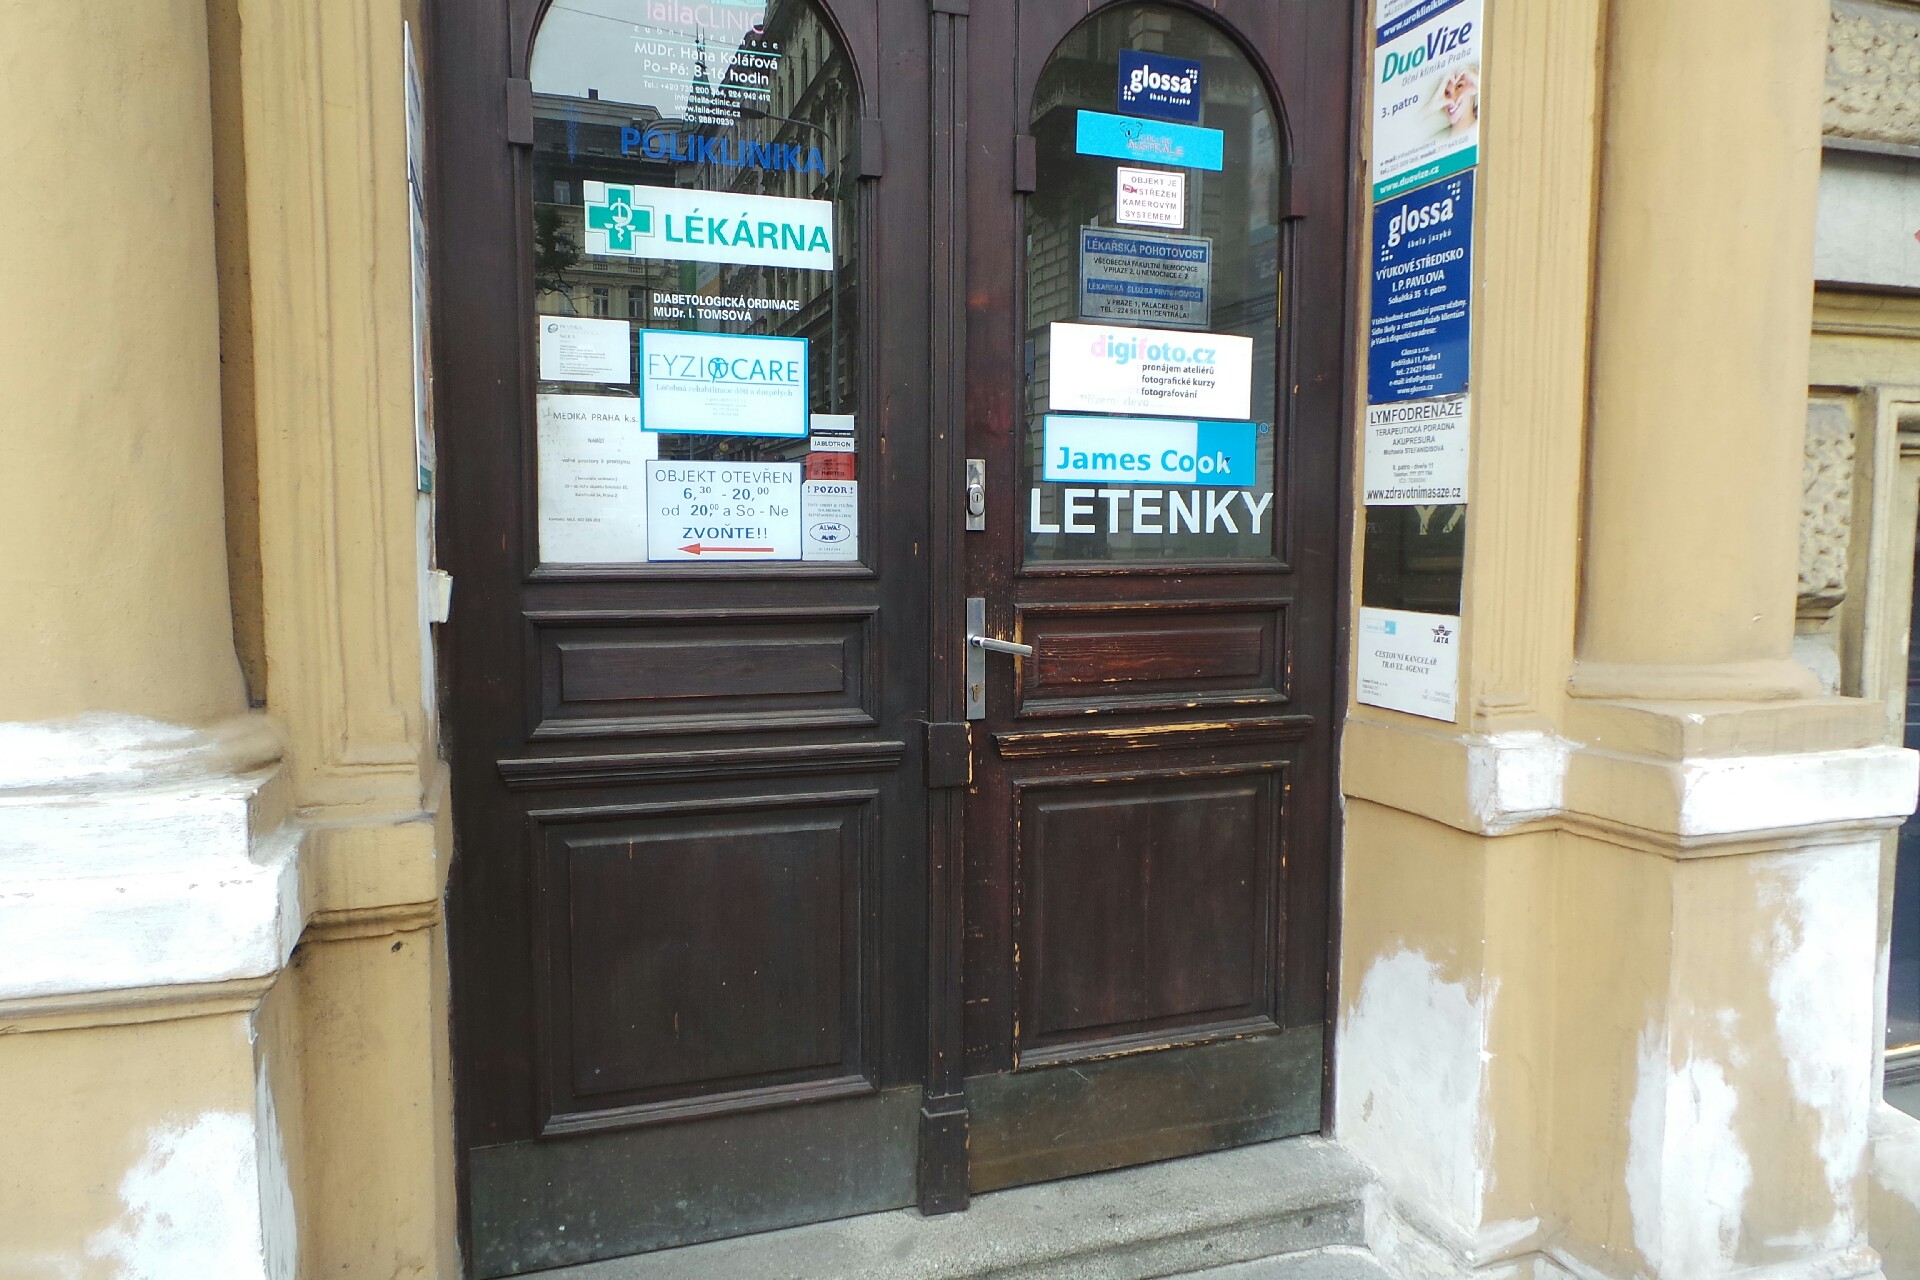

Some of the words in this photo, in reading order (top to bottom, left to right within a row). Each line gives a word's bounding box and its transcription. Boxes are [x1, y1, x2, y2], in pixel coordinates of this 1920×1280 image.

[634, 42, 676, 58] MUDr.
[680, 47, 716, 63] Hana
[720, 51, 778, 70] Kolářová
[1381, 22, 1473, 84] DuoVize
[730, 70, 769, 86] hodin
[1130, 64, 1192, 95] glossa
[1381, 107, 1390, 118] 3.
[1392, 94, 1418, 116] patro
[620, 127, 827, 175] POLIKLINIKA
[1131, 176, 1165, 186] OBJEKT
[1380, 165, 1440, 195] www.duovize.cz
[1138, 188, 1177, 198] STŘEŽEN
[1122, 198, 1177, 210] KAMEROVÝM
[1388, 197, 1454, 248] glossa
[665, 208, 832, 254] LÉKÁRNA
[1428, 230, 1452, 245] jazyků
[1086, 238, 1137, 254] LÉKAŘSKÁ
[1140, 244, 1204, 260] POHOTOVOST
[1376, 258, 1416, 281] VÝUKOVÉ
[1416, 248, 1464, 271] STŘEDISKO
[1414, 290, 1422, 300] 35
[1430, 285, 1447, 296] patro
[653, 293, 746, 309] DIABETOLOGICKÁ
[747, 298, 800, 312] ORDINACE
[653, 307, 686, 320] MUDr.
[688, 308, 696, 320] I.
[698, 308, 752, 322] TOMSOVÁ
[1090, 335, 1216, 365] digifoto.cz
[1142, 362, 1182, 374] pronájem
[1183, 364, 1214, 375] ateliérů
[1142, 374, 1191, 386] fotografické
[1192, 378, 1216, 388] kurzy
[1141, 387, 1198, 400] fotografování
[552, 412, 587, 421] MEDIKA
[592, 414, 620, 422] PRAHA
[624, 414, 638, 423] k.s.
[1423, 422, 1456, 432] PORADNA
[814, 440, 851, 448] JABLOTRON
[1392, 435, 1436, 446] AKUPRESURA
[1056, 446, 1151, 472] James
[1160, 450, 1232, 474] Cook
[655, 470, 716, 484] OBJEKT
[722, 468, 793, 485] OTEVŘEN
[813, 485, 848, 494] POZOR
[1366, 485, 1461, 500] www.zdravotnimasaze.cz
[661, 504, 680, 517] od
[722, 506, 731, 517] a
[736, 505, 756, 518] So
[770, 506, 789, 518] Ne
[1030, 488, 1274, 534] LETENKY
[682, 523, 768, 540] ZVOŇTE!!
[1433, 636, 1449, 644] IATA
[1382, 660, 1404, 671] TRAVEL
[1406, 664, 1430, 675] AGENCY
[1404, 654, 1438, 666] KANCELÁŘ
